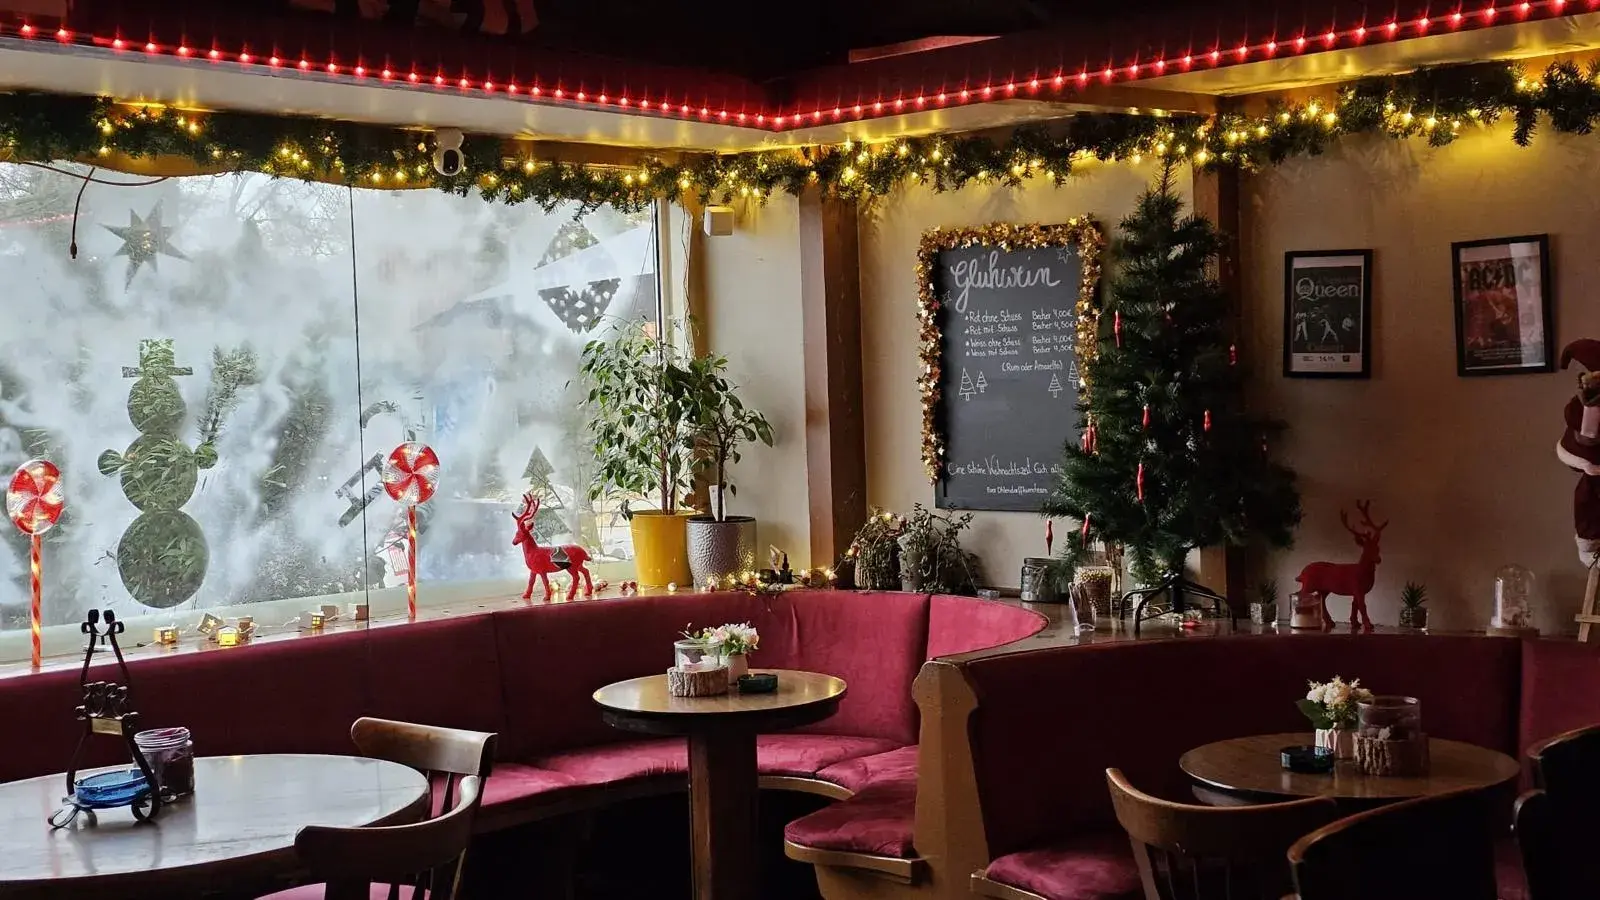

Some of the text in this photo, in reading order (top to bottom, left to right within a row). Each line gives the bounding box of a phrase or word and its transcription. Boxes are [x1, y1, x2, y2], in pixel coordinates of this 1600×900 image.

[1296, 277, 1359, 302] Queen
[969, 310, 981, 322] Rot
[982, 310, 999, 323] ohne
[1000, 309, 1023, 322] Schuss
[969, 325, 982, 335] Rot
[983, 325, 994, 334] mit
[997, 324, 1018, 332] Schuss
[988, 338, 1002, 347] ohne
